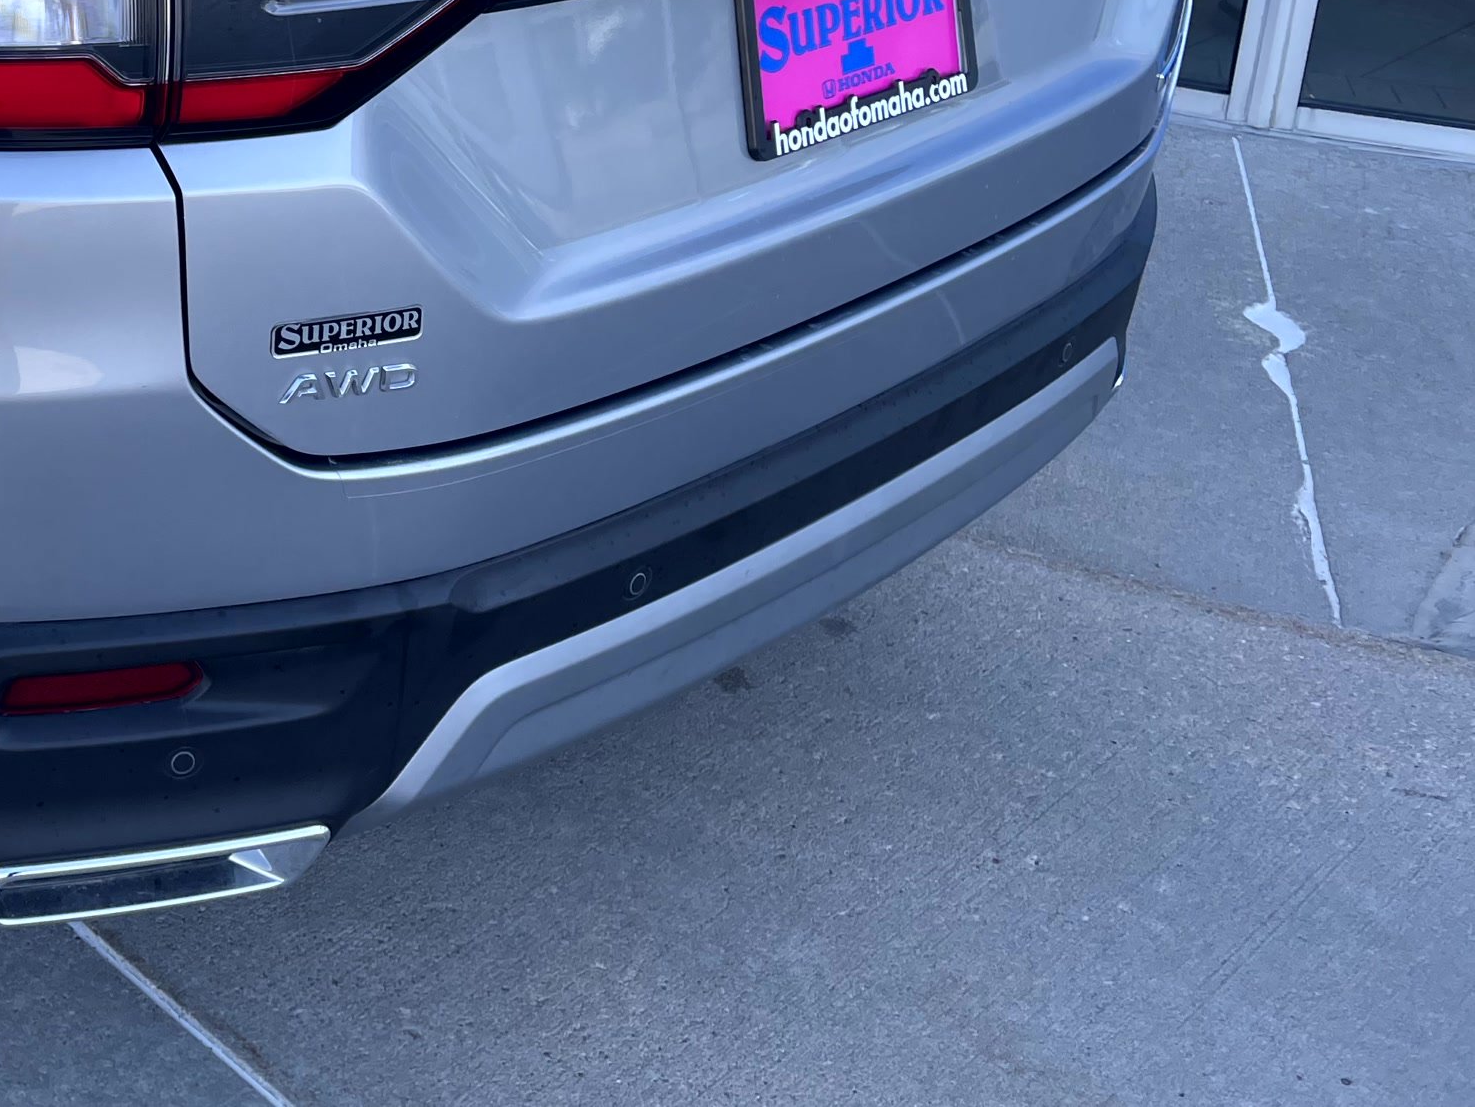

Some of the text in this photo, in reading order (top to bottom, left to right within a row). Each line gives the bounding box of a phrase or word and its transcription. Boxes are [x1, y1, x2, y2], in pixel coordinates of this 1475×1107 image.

[837, 62, 896, 92] HONDA
[774, 72, 968, 156] hondaofomaha.com
[277, 309, 419, 351] SUPERIOR
[320, 338, 377, 354] Omaha
[278, 363, 417, 405] AWD
